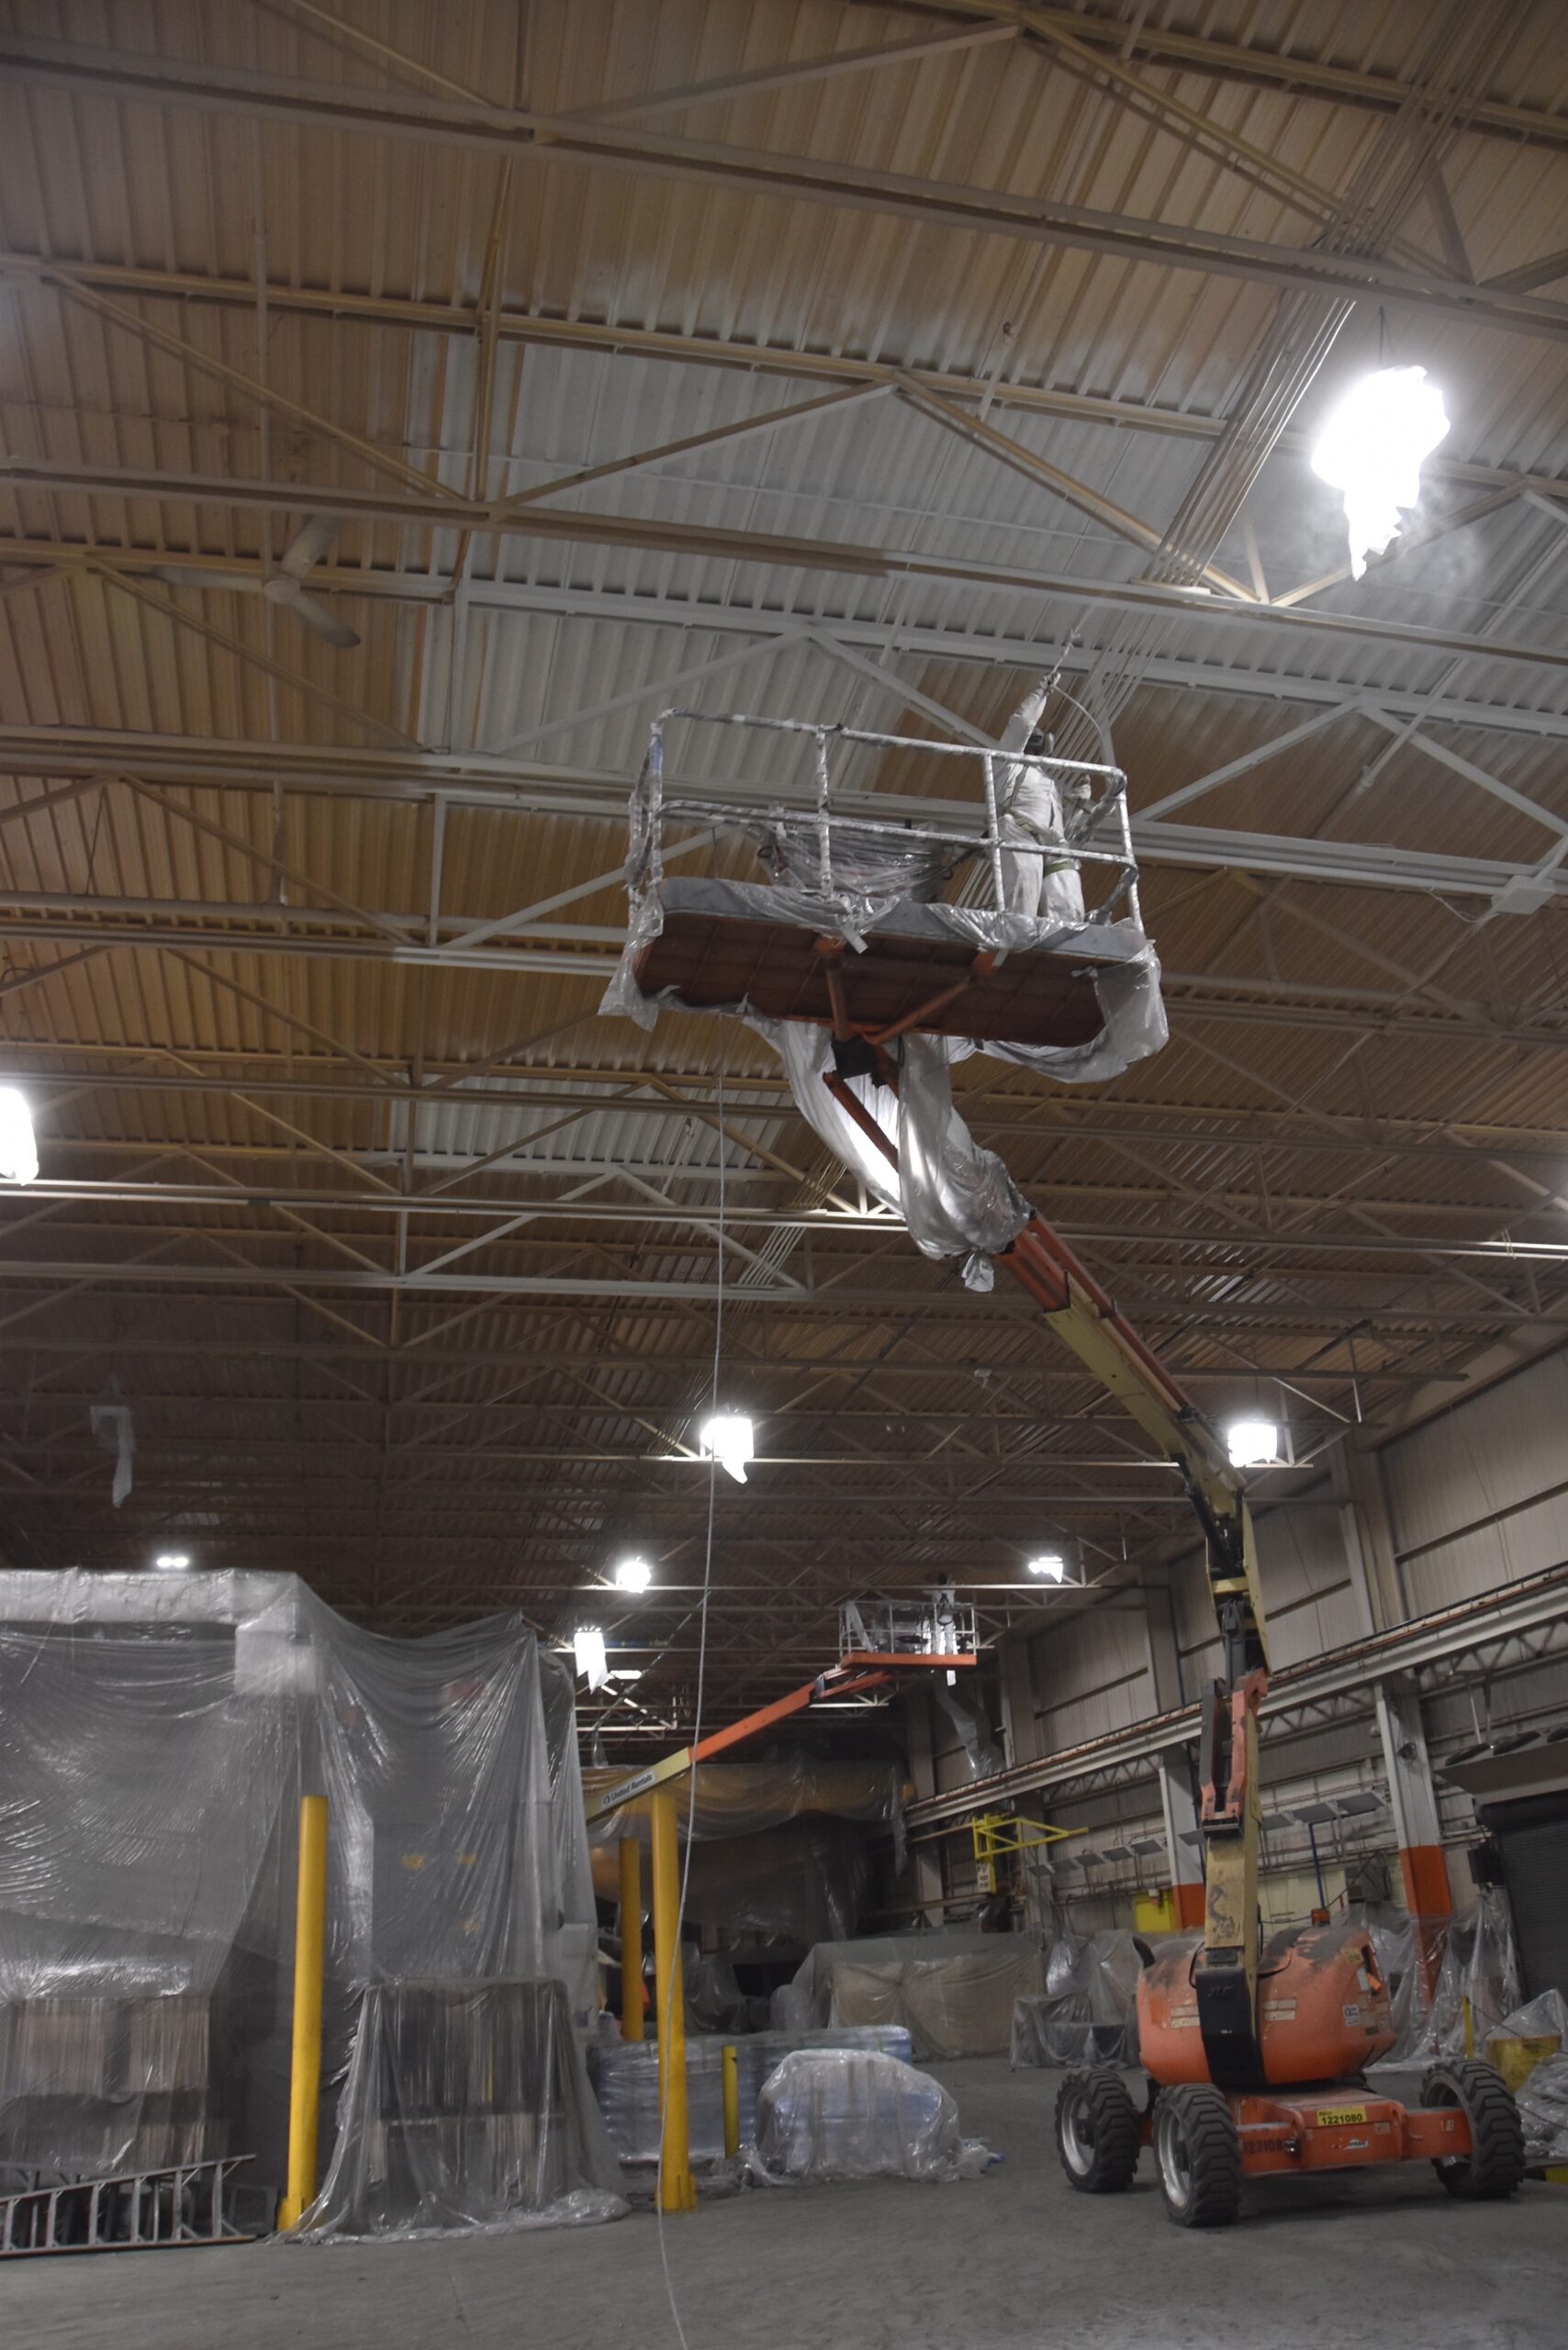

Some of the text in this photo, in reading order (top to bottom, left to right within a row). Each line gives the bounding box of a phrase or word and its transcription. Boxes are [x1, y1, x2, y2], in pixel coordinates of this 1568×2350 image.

[610, 1774, 653, 1801] United Rentals
[1321, 2113, 1363, 2125] 1221080
[1242, 2139, 1285, 2154] 122108
